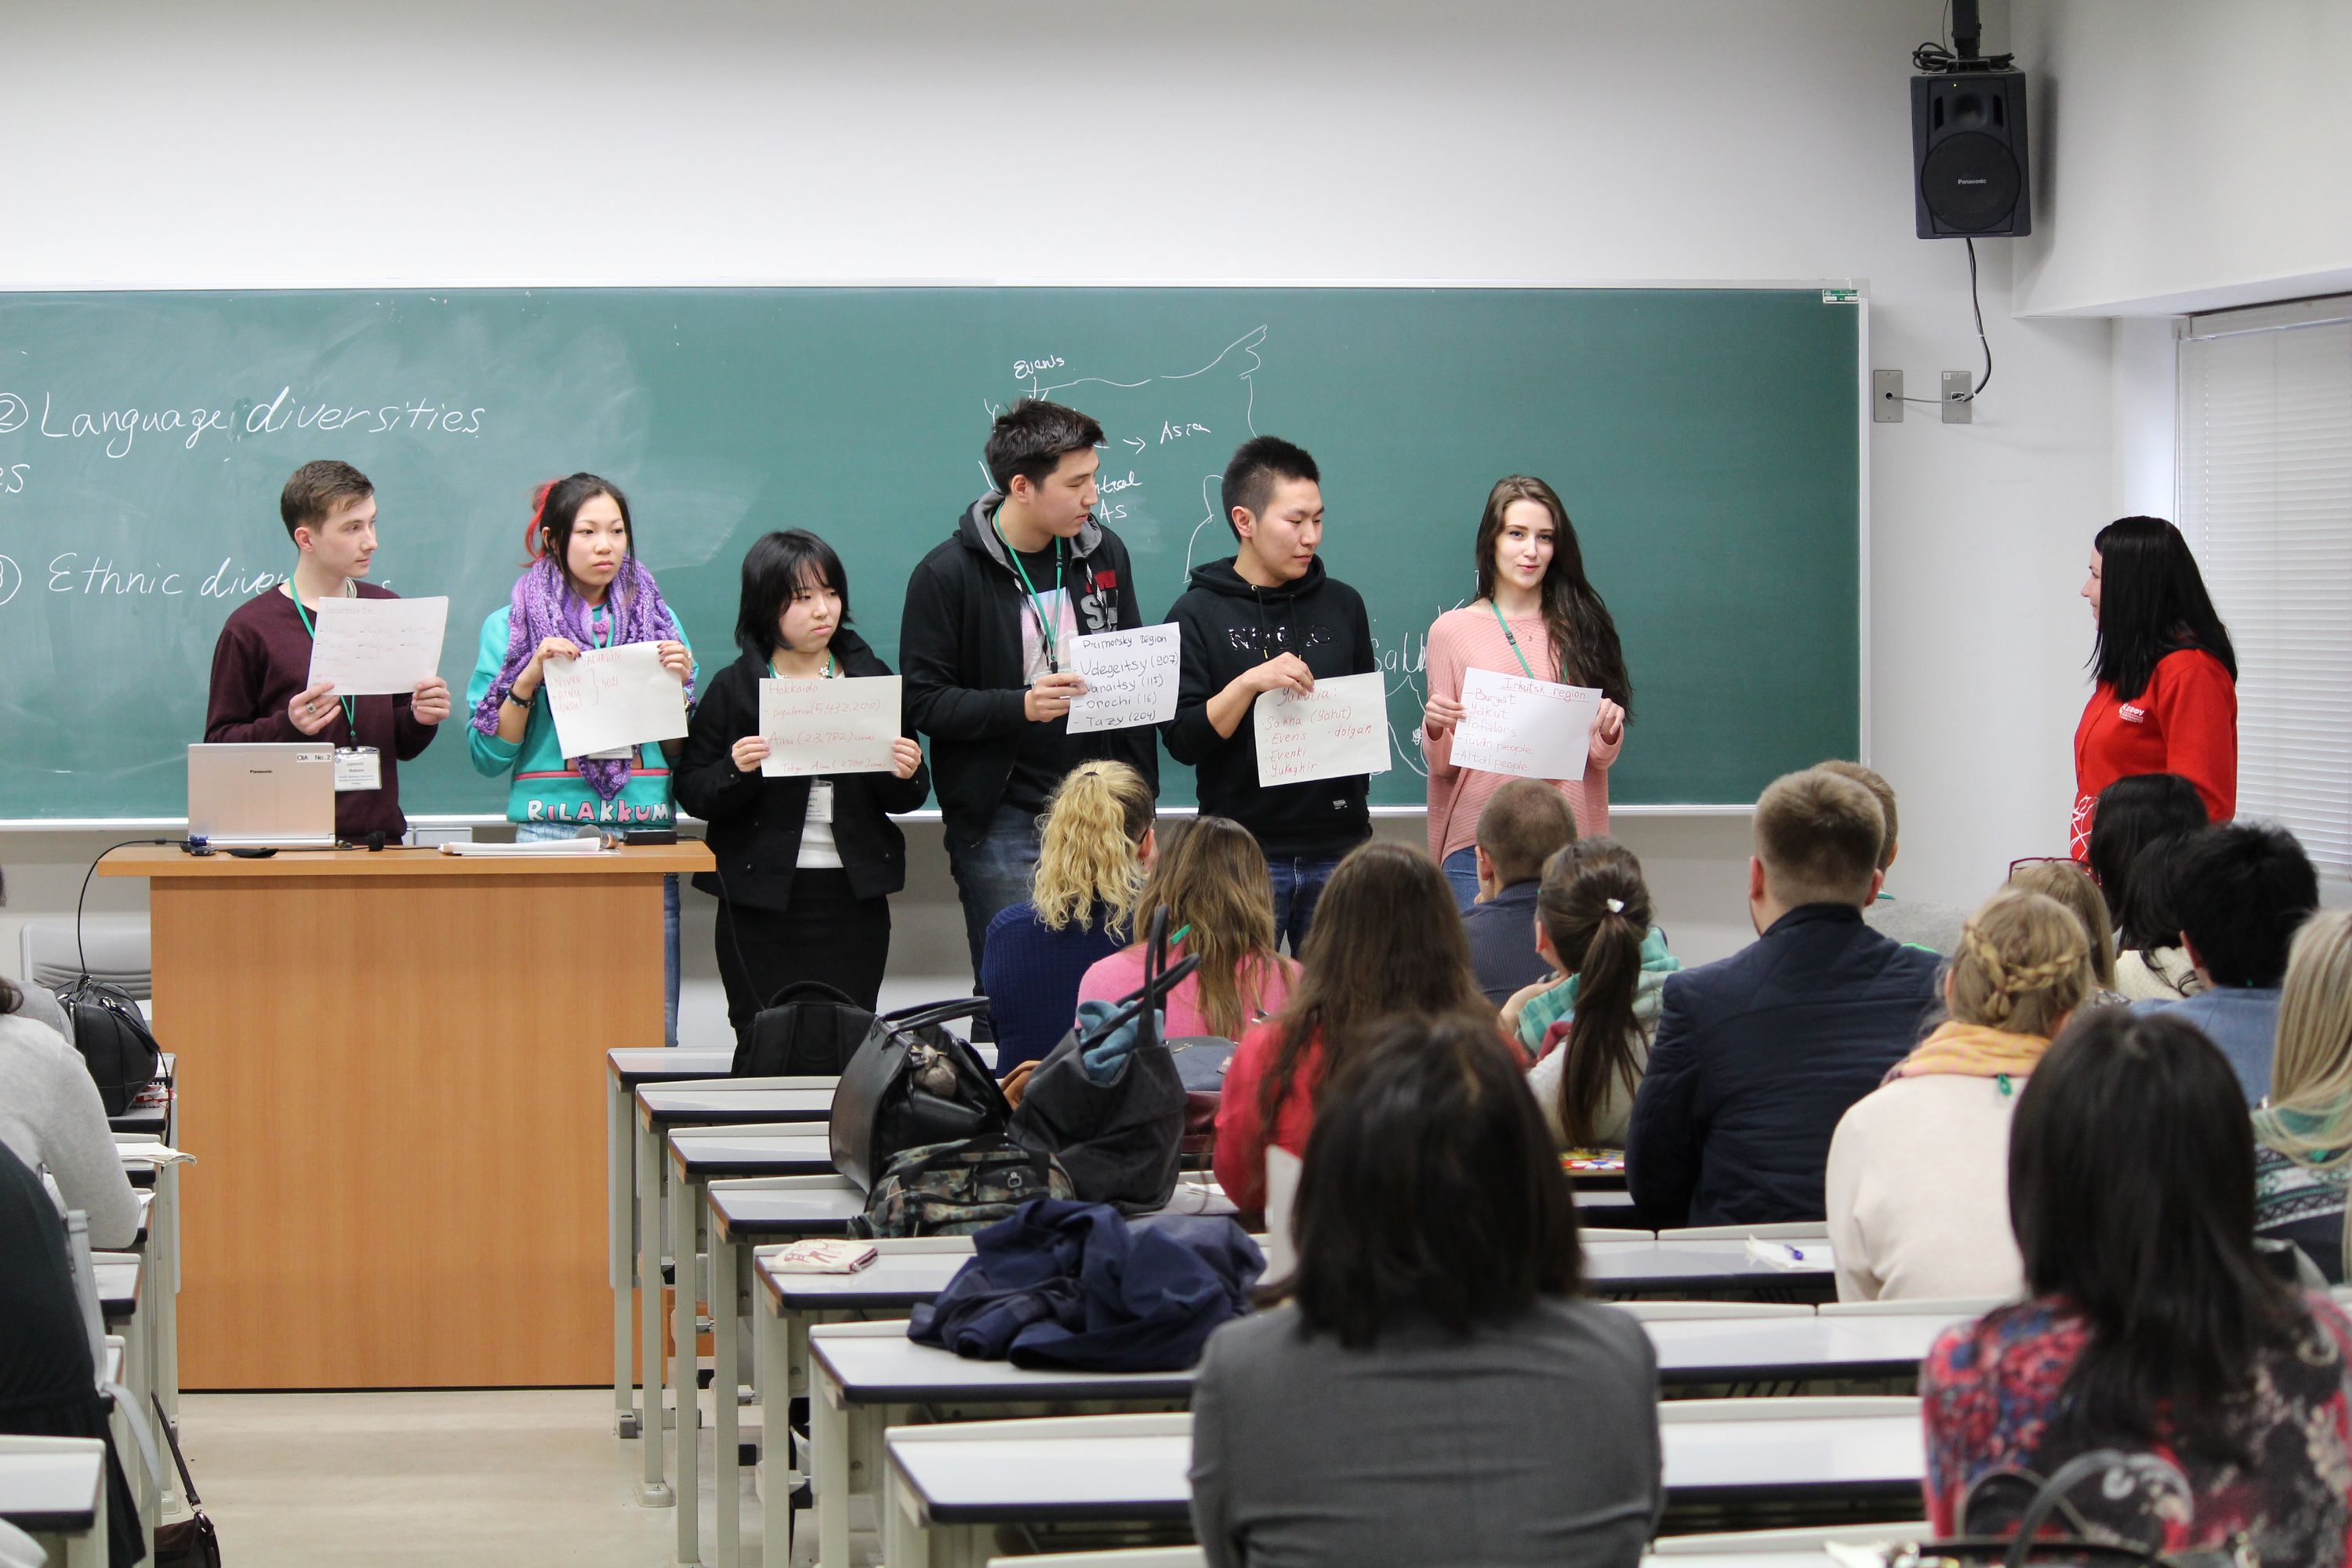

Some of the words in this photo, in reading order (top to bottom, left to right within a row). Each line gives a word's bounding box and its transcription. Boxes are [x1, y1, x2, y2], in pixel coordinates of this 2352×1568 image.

[42, 390, 228, 459] Language
[246, 386, 485, 439] diversities
[49, 552, 183, 595] Ethnic
[1080, 659, 1148, 678] Udegeitsy
[768, 681, 818, 695] Hokkaido
[1504, 677, 1545, 694] Irkutsk
[1137, 691, 1157, 705] (16)
[1475, 688, 1517, 706] Buryat
[1086, 716, 1124, 728] Tazy
[1129, 710, 1156, 722] (204)
[1469, 702, 1510, 719] Yakut
[1265, 716, 1301, 731] Sakha
[768, 731, 794, 746] Ainu
[1272, 732, 1307, 745] Evens
[1335, 724, 1374, 739] dolgan
[1270, 746, 1307, 762] Evenki
[1497, 742, 1534, 756] people
[1460, 750, 1492, 765] Altai
[1495, 757, 1530, 772] people
[527, 799, 677, 823] RILAKKUM
